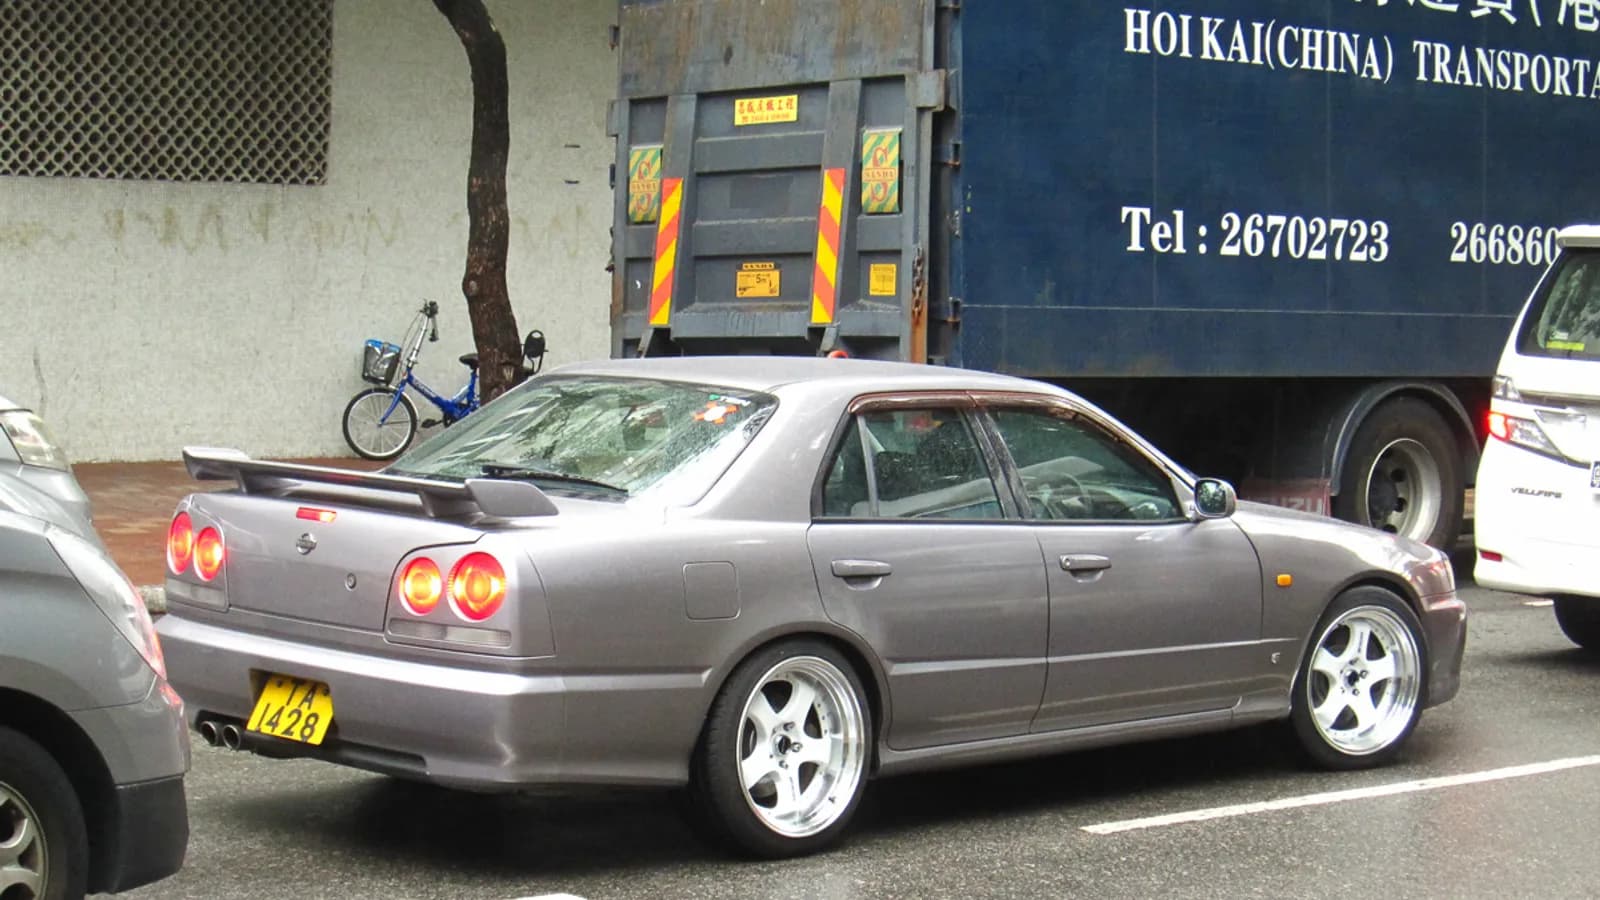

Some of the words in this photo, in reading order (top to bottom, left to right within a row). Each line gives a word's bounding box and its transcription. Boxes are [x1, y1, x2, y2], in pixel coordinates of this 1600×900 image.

[1124, 8, 1192, 58] HOI
[1200, 16, 1393, 84] KAI(CHINA)
[1220, 212, 1389, 262] 26702723
[1511, 487, 1563, 499] VELLFIRE
[286, 679, 318, 710] TA
[256, 703, 319, 742] 1428
